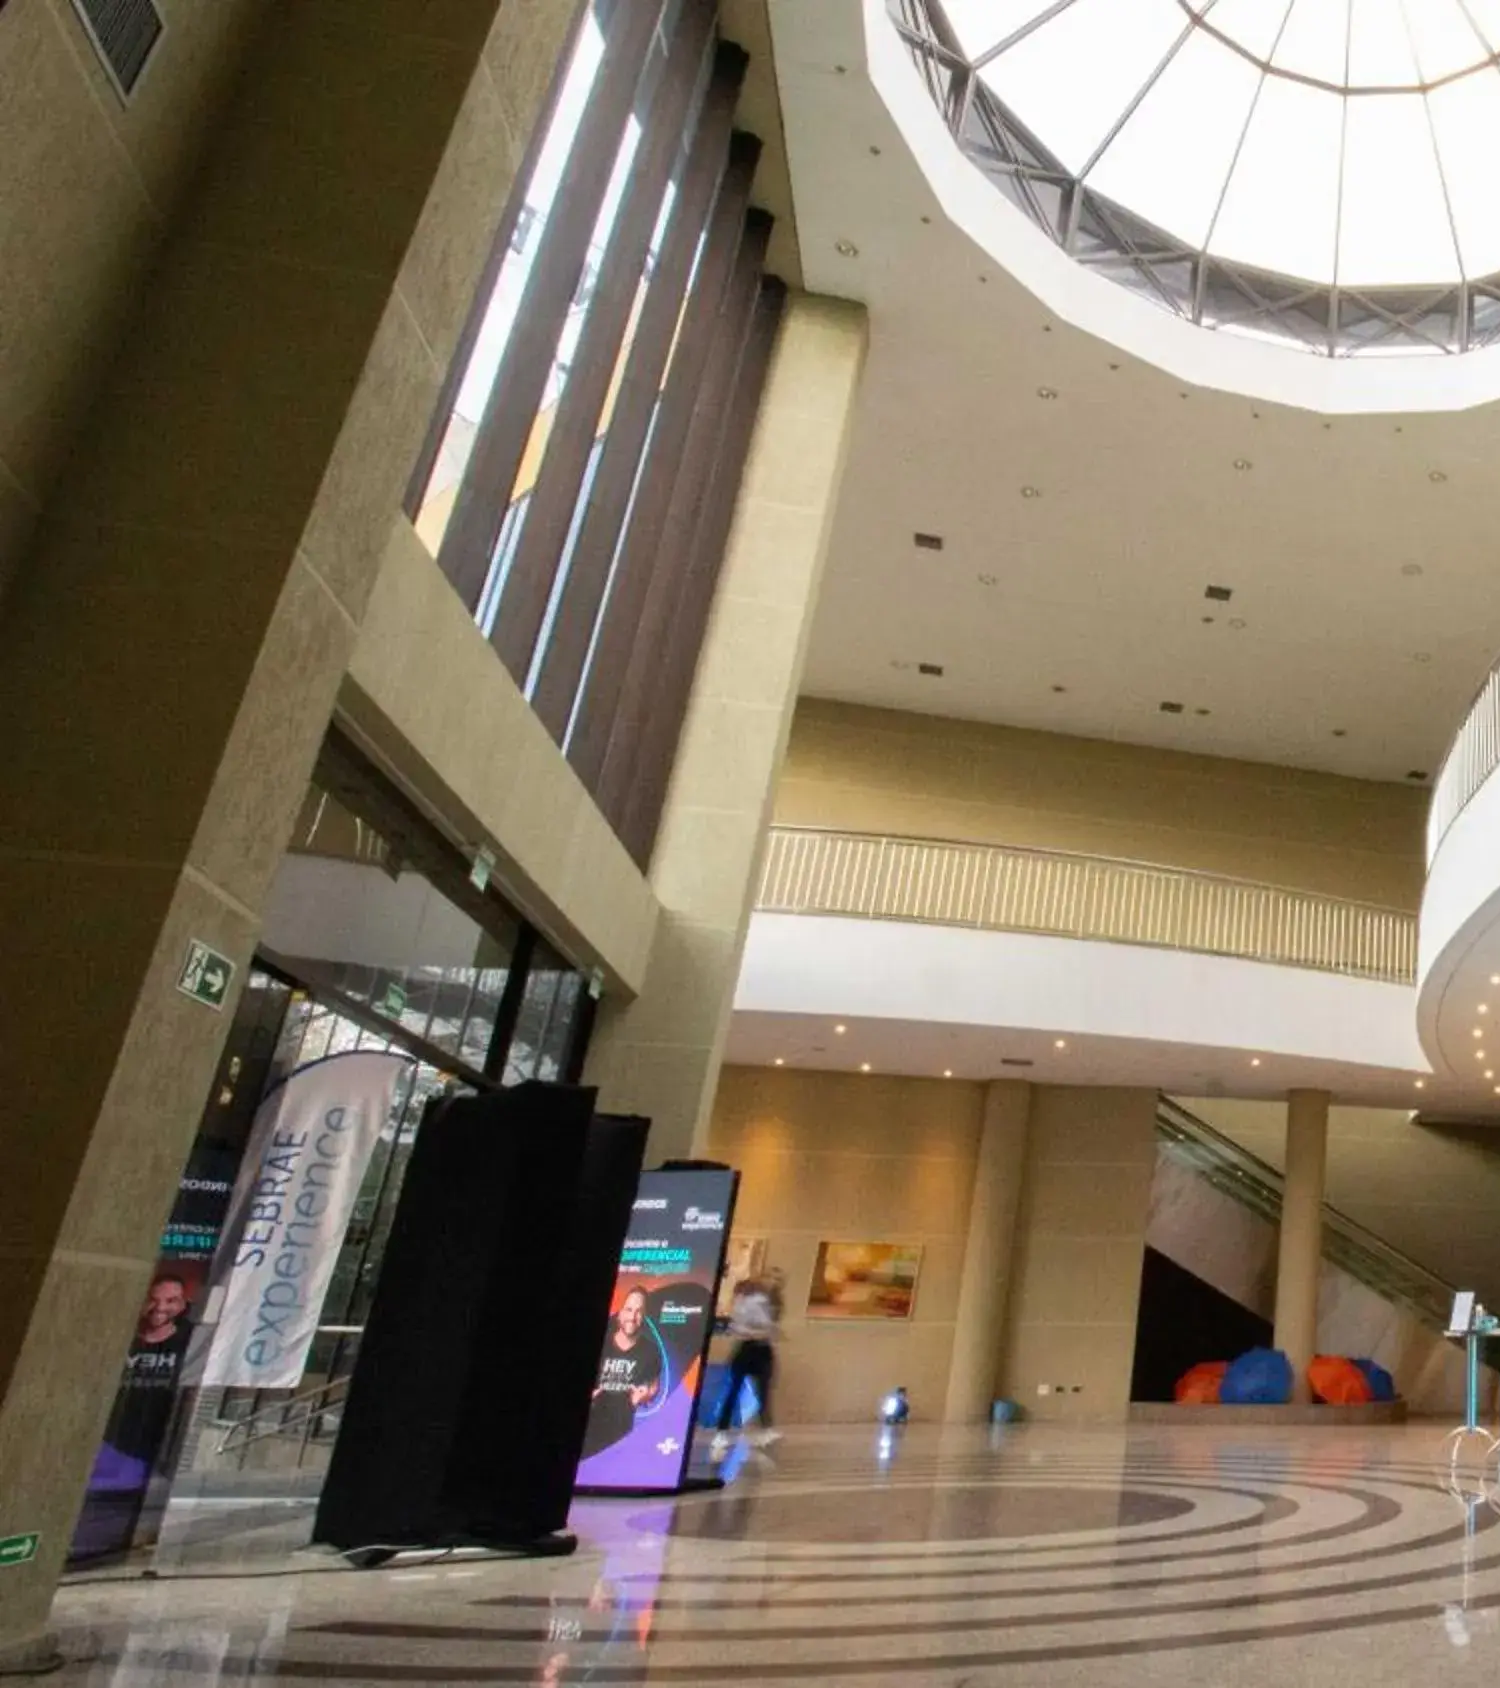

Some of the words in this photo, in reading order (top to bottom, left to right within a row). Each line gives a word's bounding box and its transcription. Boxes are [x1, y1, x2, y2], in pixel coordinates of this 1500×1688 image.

[233, 1130, 308, 1268] SEBRAE
[244, 1105, 349, 1366] experience
[603, 1358, 637, 1373] HEY
